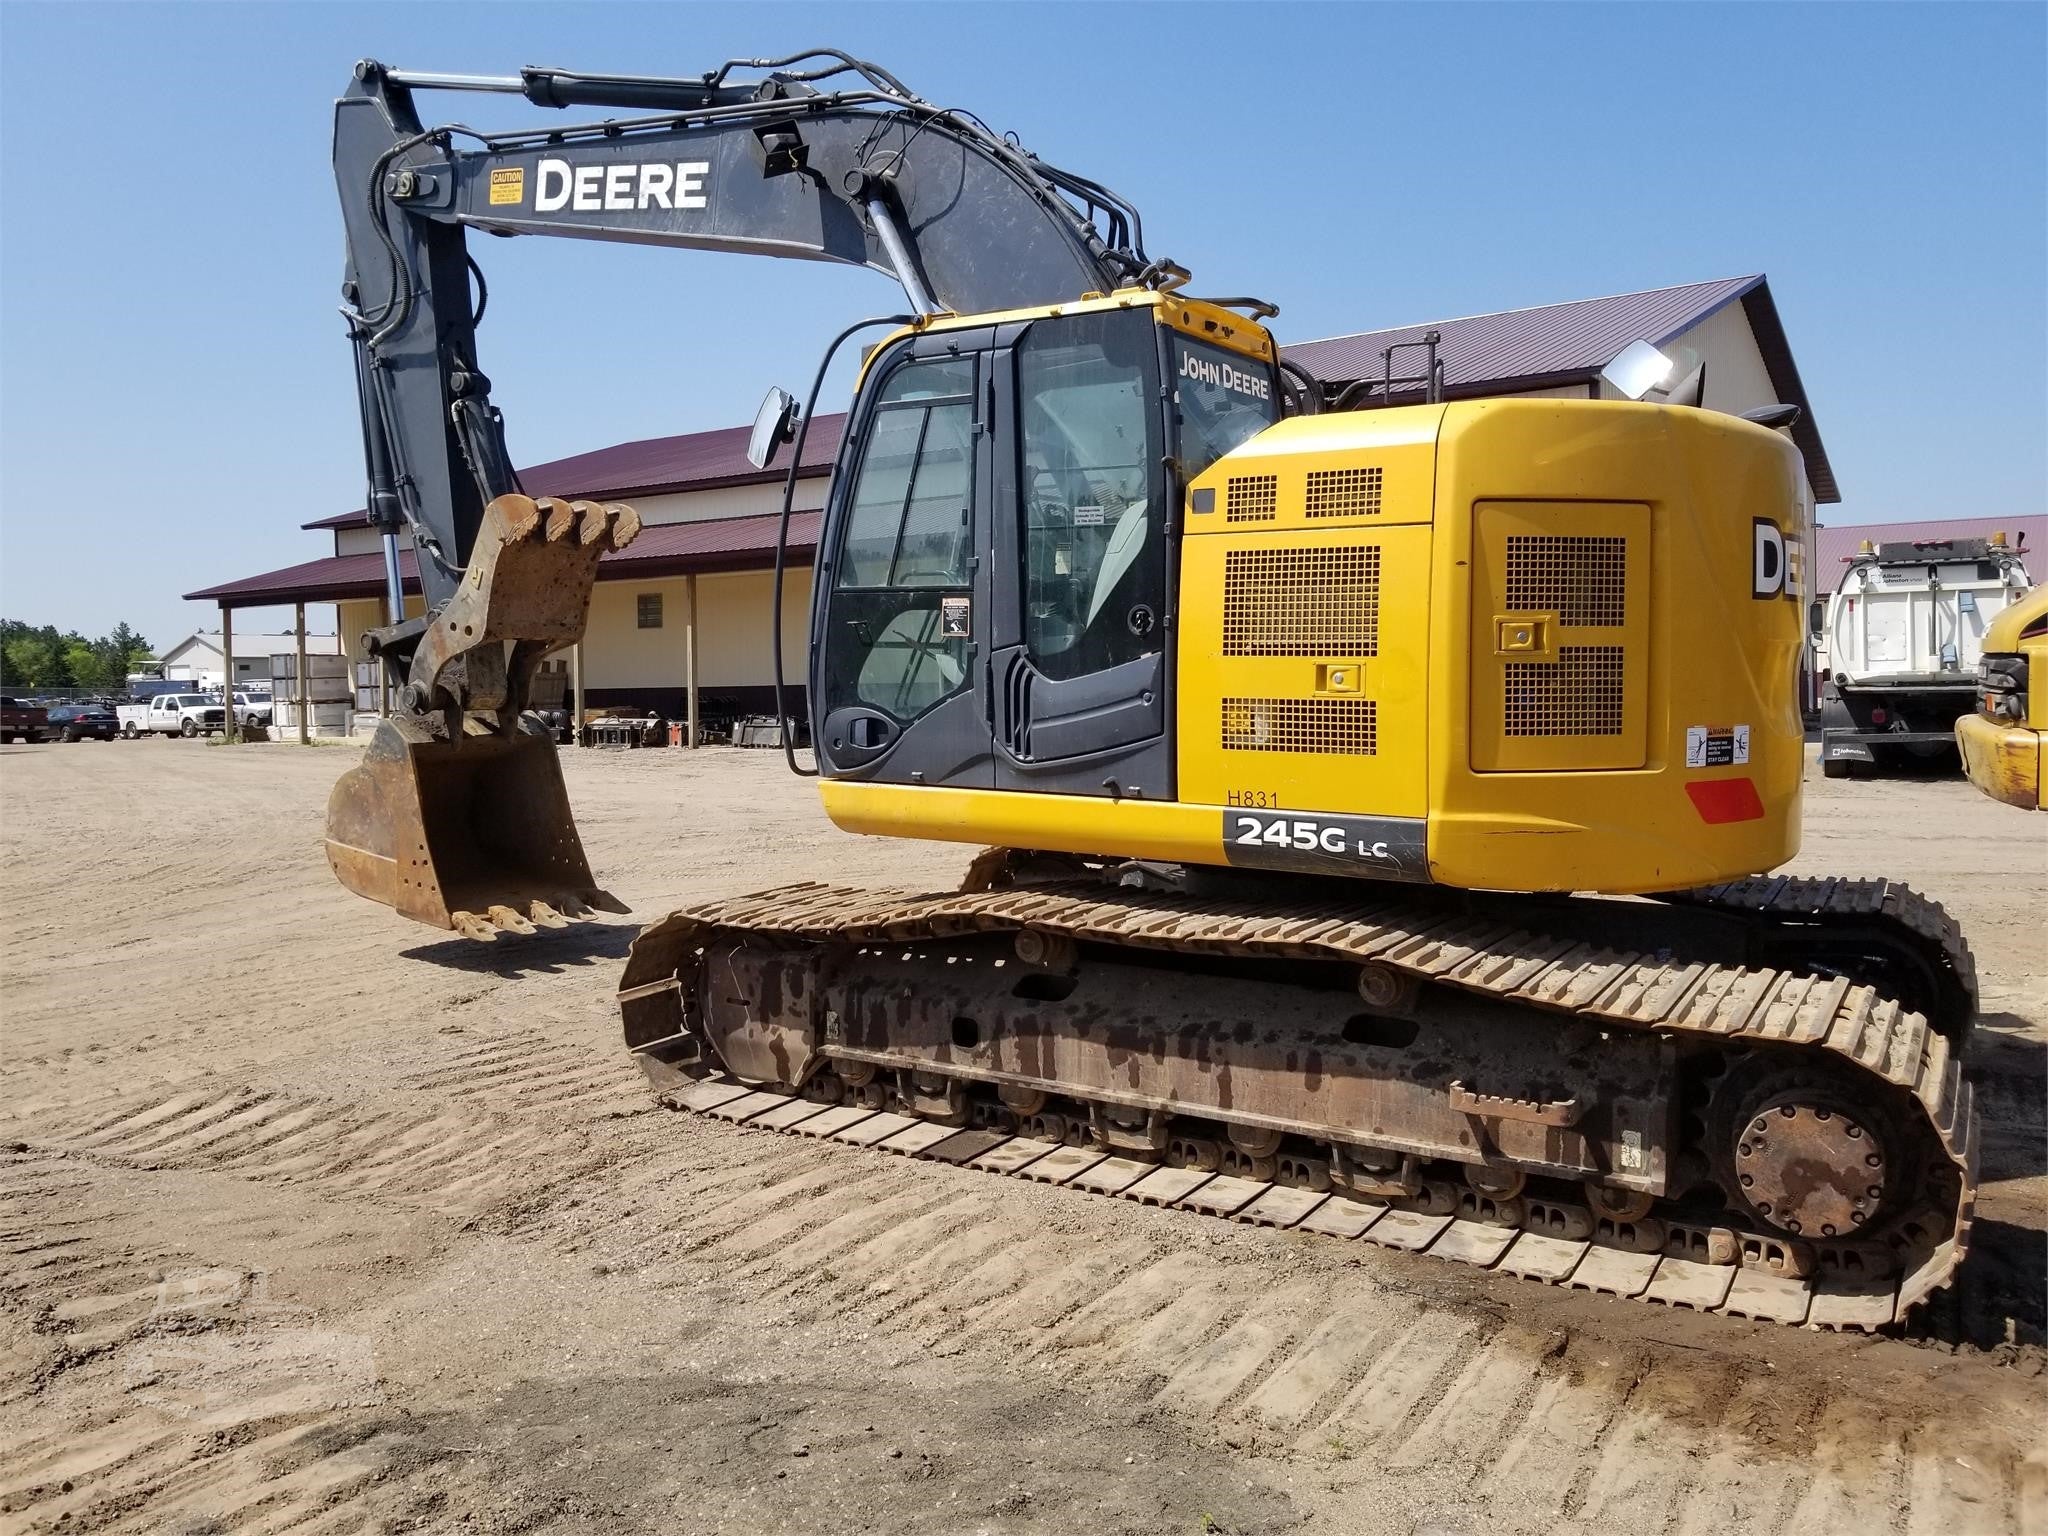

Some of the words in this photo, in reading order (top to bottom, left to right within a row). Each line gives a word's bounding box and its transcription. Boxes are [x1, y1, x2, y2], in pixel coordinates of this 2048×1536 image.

[493, 172, 522, 183] CAUTION
[536, 160, 709, 212] DEERE
[1179, 351, 1219, 386] JOHN
[1222, 363, 1269, 400] DEERE
[1228, 790, 1278, 808] H831
[1237, 817, 1345, 852] 245G
[1358, 840, 1388, 858] LC
